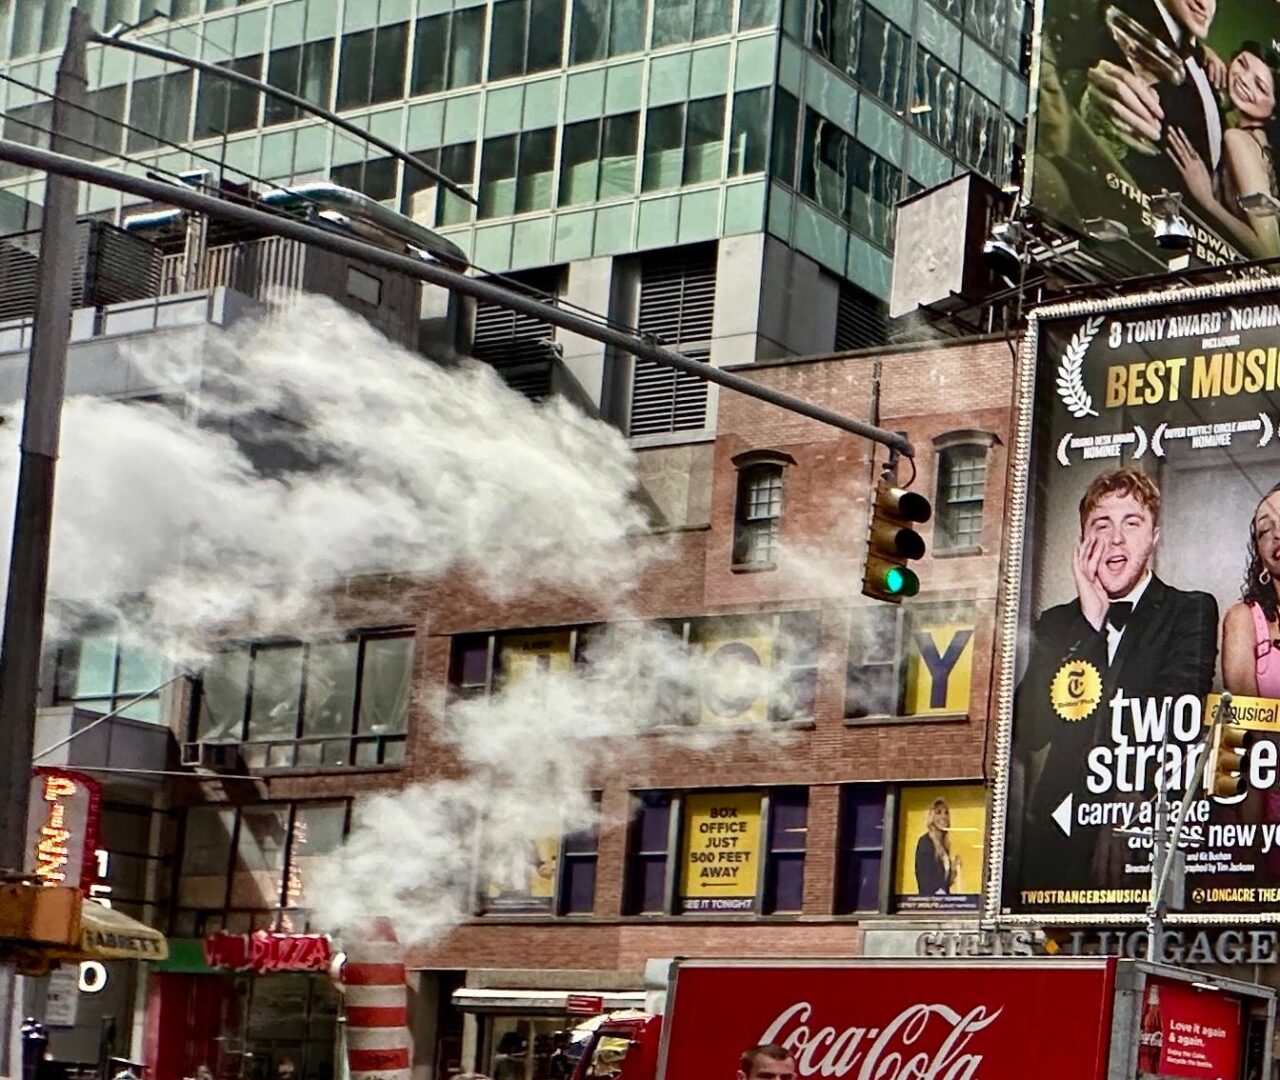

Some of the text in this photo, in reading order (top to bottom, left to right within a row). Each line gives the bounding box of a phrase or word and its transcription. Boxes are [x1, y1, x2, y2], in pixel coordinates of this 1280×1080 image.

[1109, 321, 1122, 348] 8
[1127, 318, 1165, 344] TONY
[1106, 357, 1187, 408] BEST
[1109, 688, 1201, 744] two
[709, 807, 738, 819] BOX
[1077, 801, 1134, 827] carry
[699, 822, 747, 833] OFFICE
[1208, 823, 1258, 847] new
[705, 837, 739, 849] JUST
[690, 851, 751, 863] 500 FEET
[700, 866, 739, 878] AWAY
[1207, 888, 1256, 903] LONGACRE
[711, 898, 753, 909] TONIGHT
[1169, 1019, 1192, 1033] Love
[1202, 1026, 1227, 1038] again
[1177, 1034, 1206, 1047] again.
